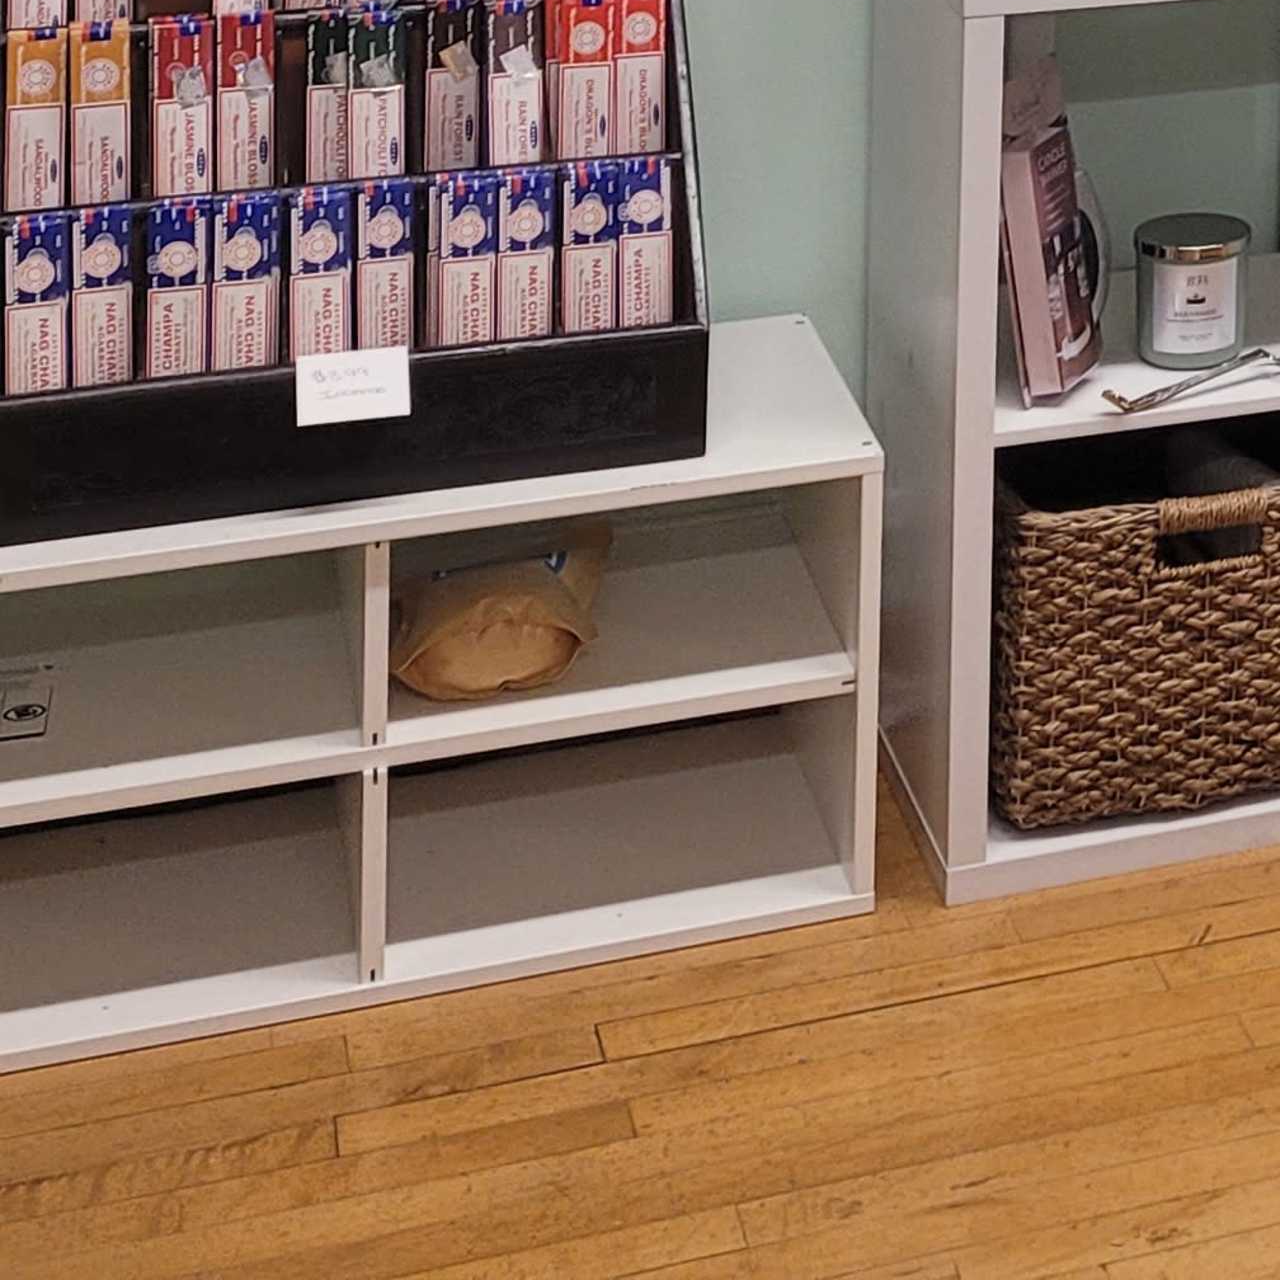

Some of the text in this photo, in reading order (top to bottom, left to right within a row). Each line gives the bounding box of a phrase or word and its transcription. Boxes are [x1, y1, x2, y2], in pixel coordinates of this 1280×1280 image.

[388, 271, 400, 304] NAG
[470, 271, 480, 304] NAG
[527, 264, 539, 297] NAG
[591, 258, 602, 289] NAG
[634, 247, 643, 313] CHAMPA
[105, 302, 117, 335] NAG
[244, 294, 256, 327] NAG
[322, 287, 333, 320] NAG
[39, 317, 50, 351] NAG
[162, 302, 174, 370] CHAMPA
